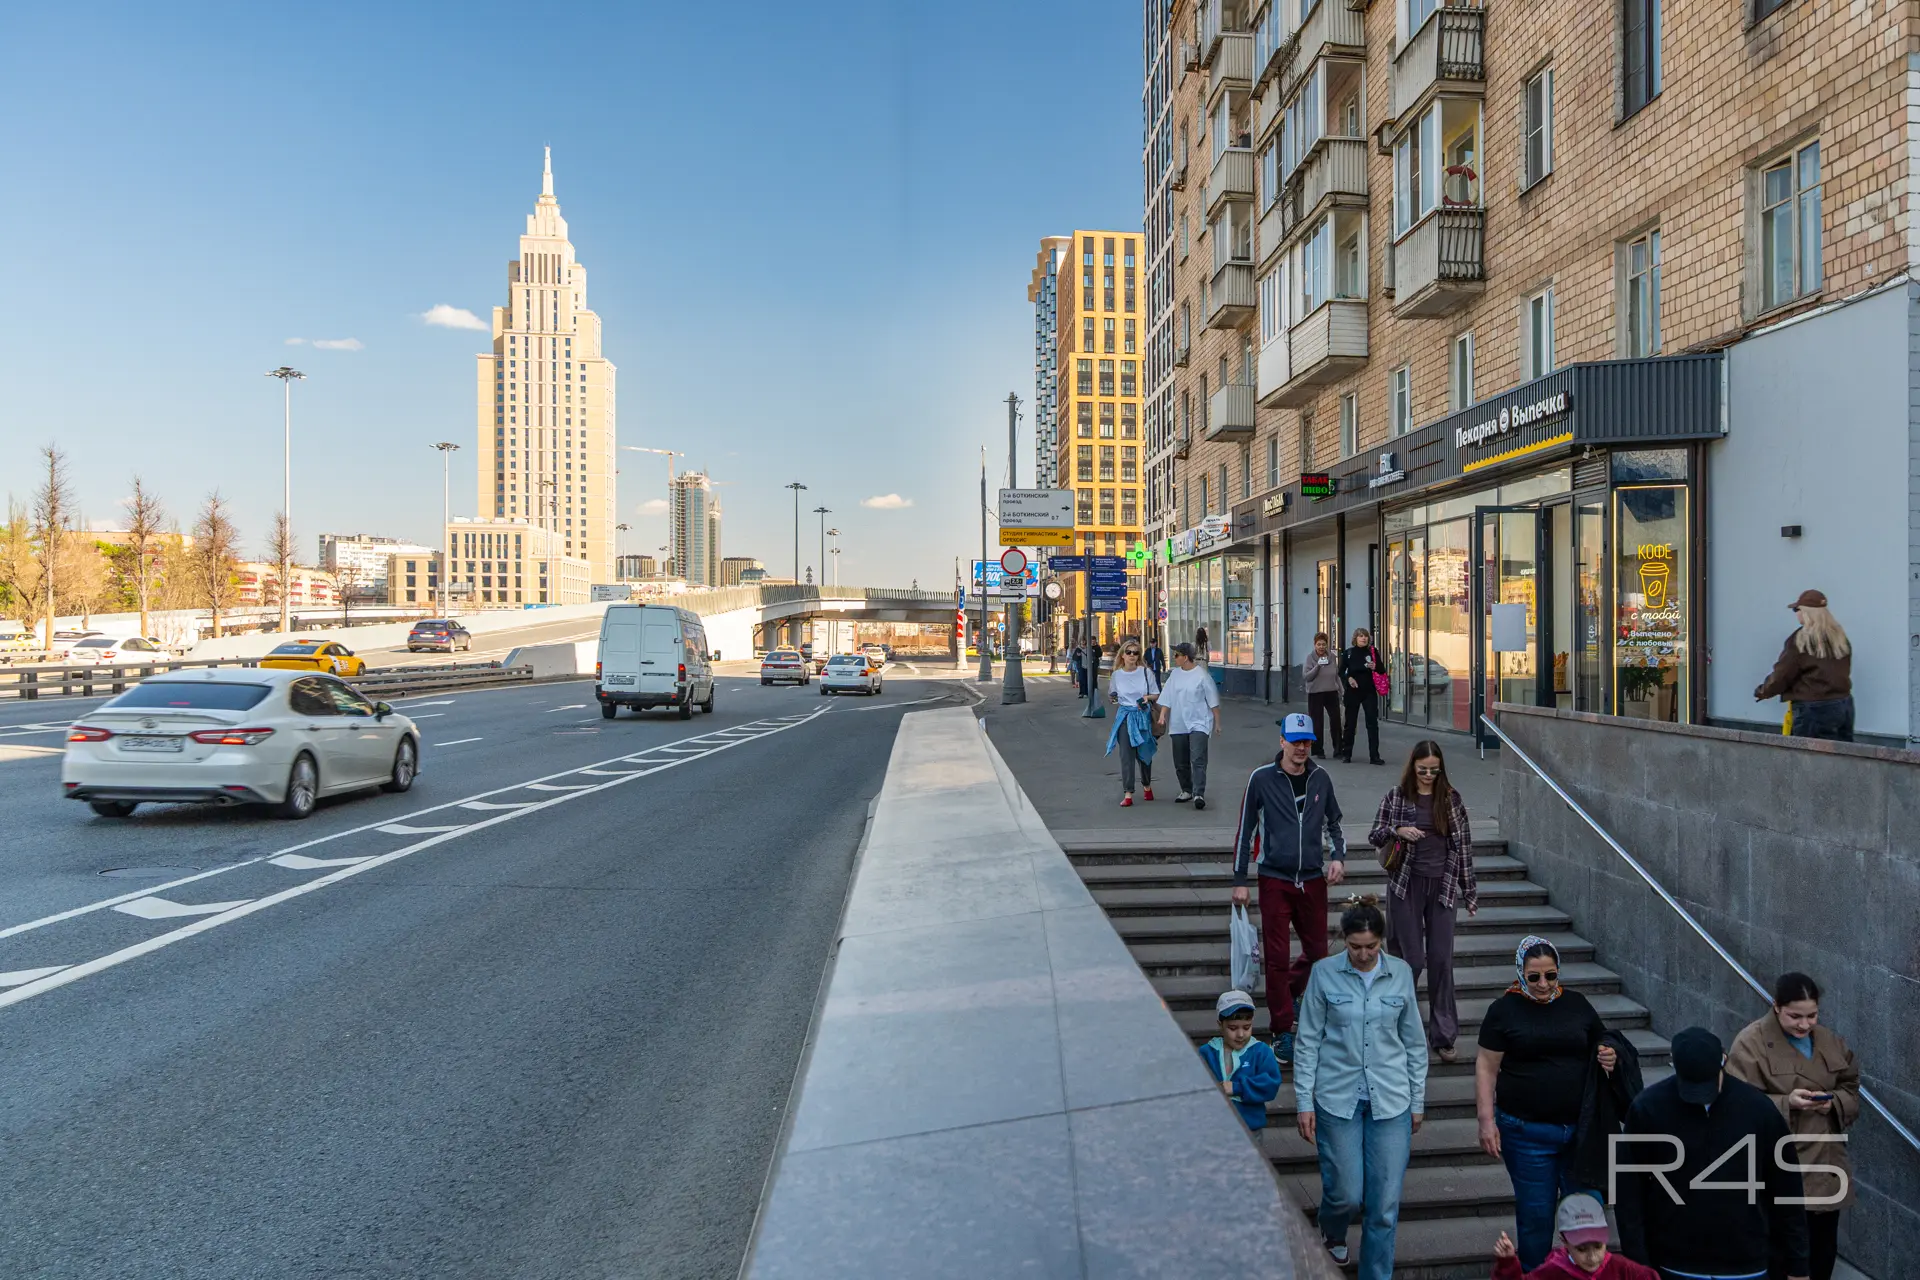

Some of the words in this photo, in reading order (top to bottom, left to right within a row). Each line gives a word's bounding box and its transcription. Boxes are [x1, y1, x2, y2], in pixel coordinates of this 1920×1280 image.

[1455, 419, 1498, 448] Пекарня
[1511, 392, 1565, 428] Выпечка
[1302, 475, 1328, 484] ТАБАК
[1302, 486, 1328, 494] ПИВО
[1637, 543, 1673, 560] КОФЕ
[1630, 612, 1638, 620] с
[1641, 608, 1681, 620] тобой
